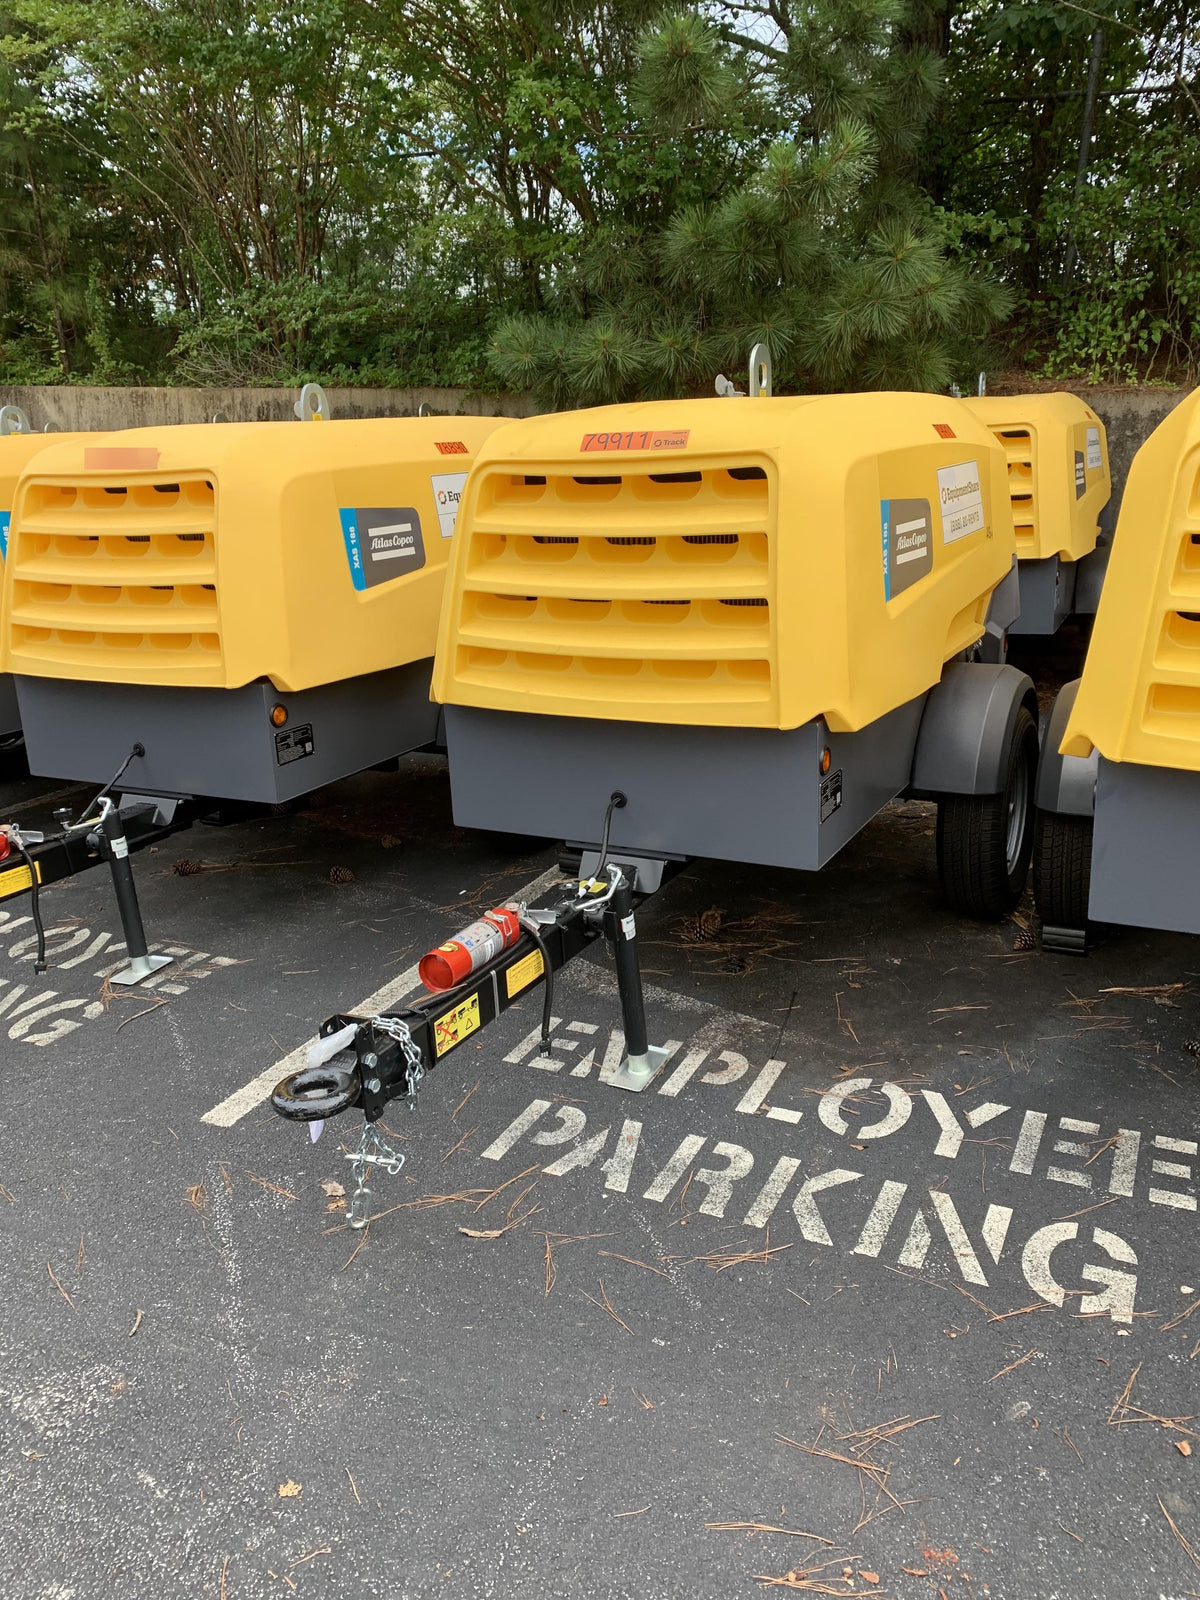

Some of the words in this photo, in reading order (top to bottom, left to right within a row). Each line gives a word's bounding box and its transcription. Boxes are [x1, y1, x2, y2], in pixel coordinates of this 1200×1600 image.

[583, 431, 649, 451] 79911
[351, 547, 360, 569] XAS
[502, 1016, 1198, 1212] EMPLOYEE
[480, 1098, 1138, 1324] PARKING
